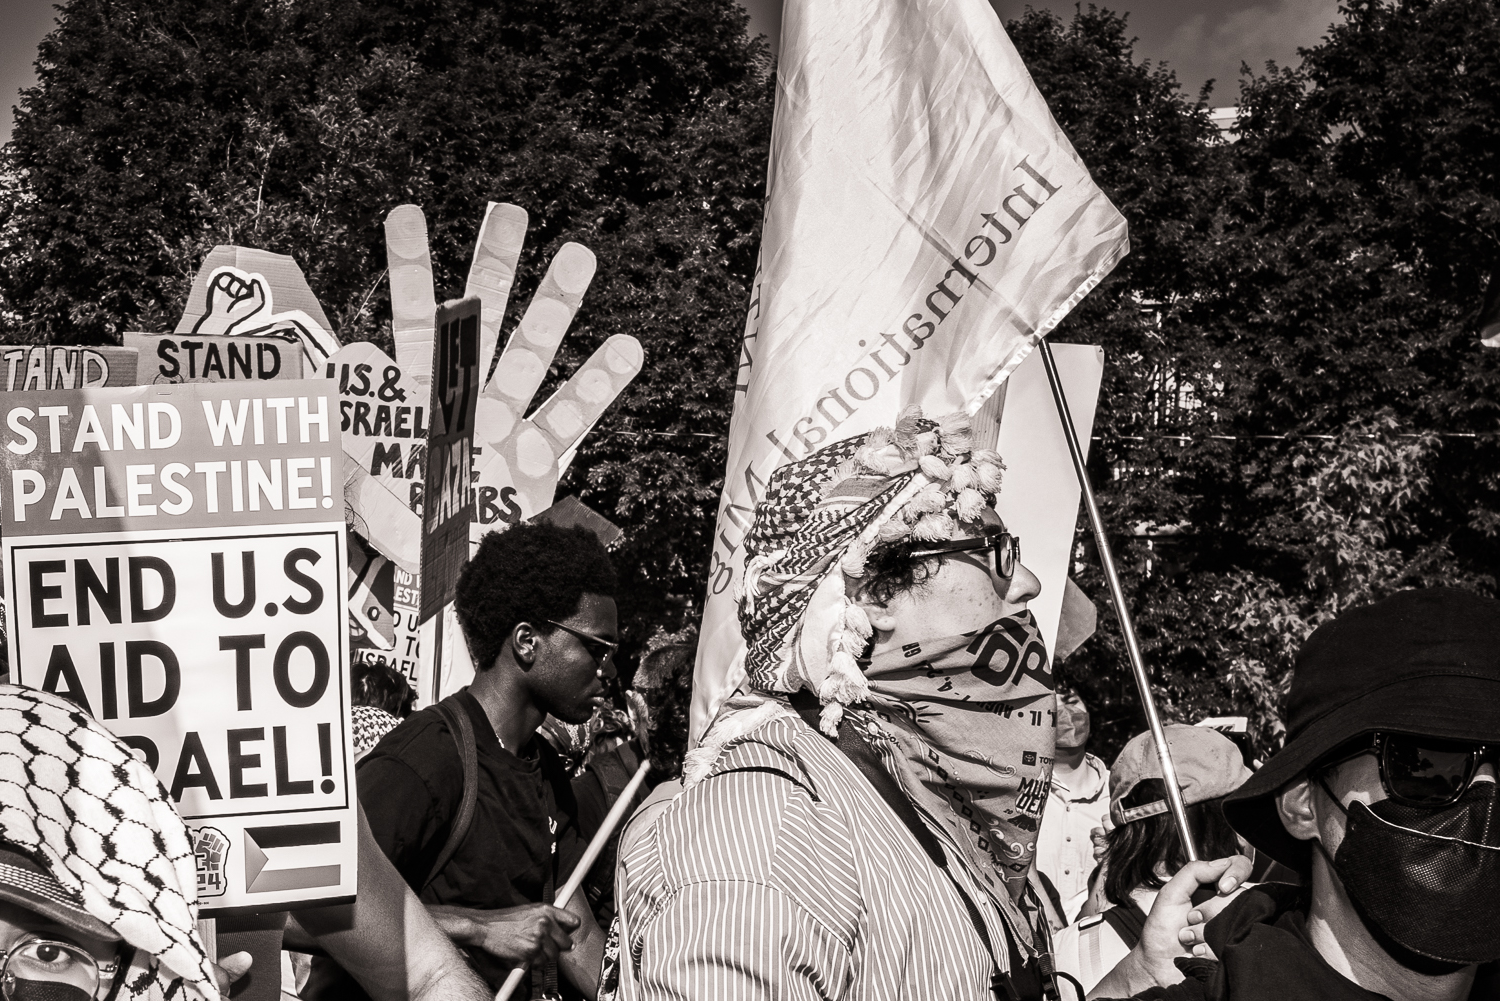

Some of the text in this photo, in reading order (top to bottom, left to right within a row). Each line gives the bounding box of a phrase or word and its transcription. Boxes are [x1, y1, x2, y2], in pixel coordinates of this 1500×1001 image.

[157, 339, 282, 381] STAND
[6, 402, 182, 455] STAND
[201, 396, 331, 447] WITH
[340, 401, 429, 440] SRAEL
[11, 456, 335, 522] PALESTINE!
[409, 482, 522, 525] BBS
[426, 437, 470, 535] GAZA
[28, 555, 177, 629] END
[210, 547, 325, 619] U.S
[41, 639, 182, 721] AID
[218, 630, 331, 712] TO
[117, 722, 336, 803] AEL!
